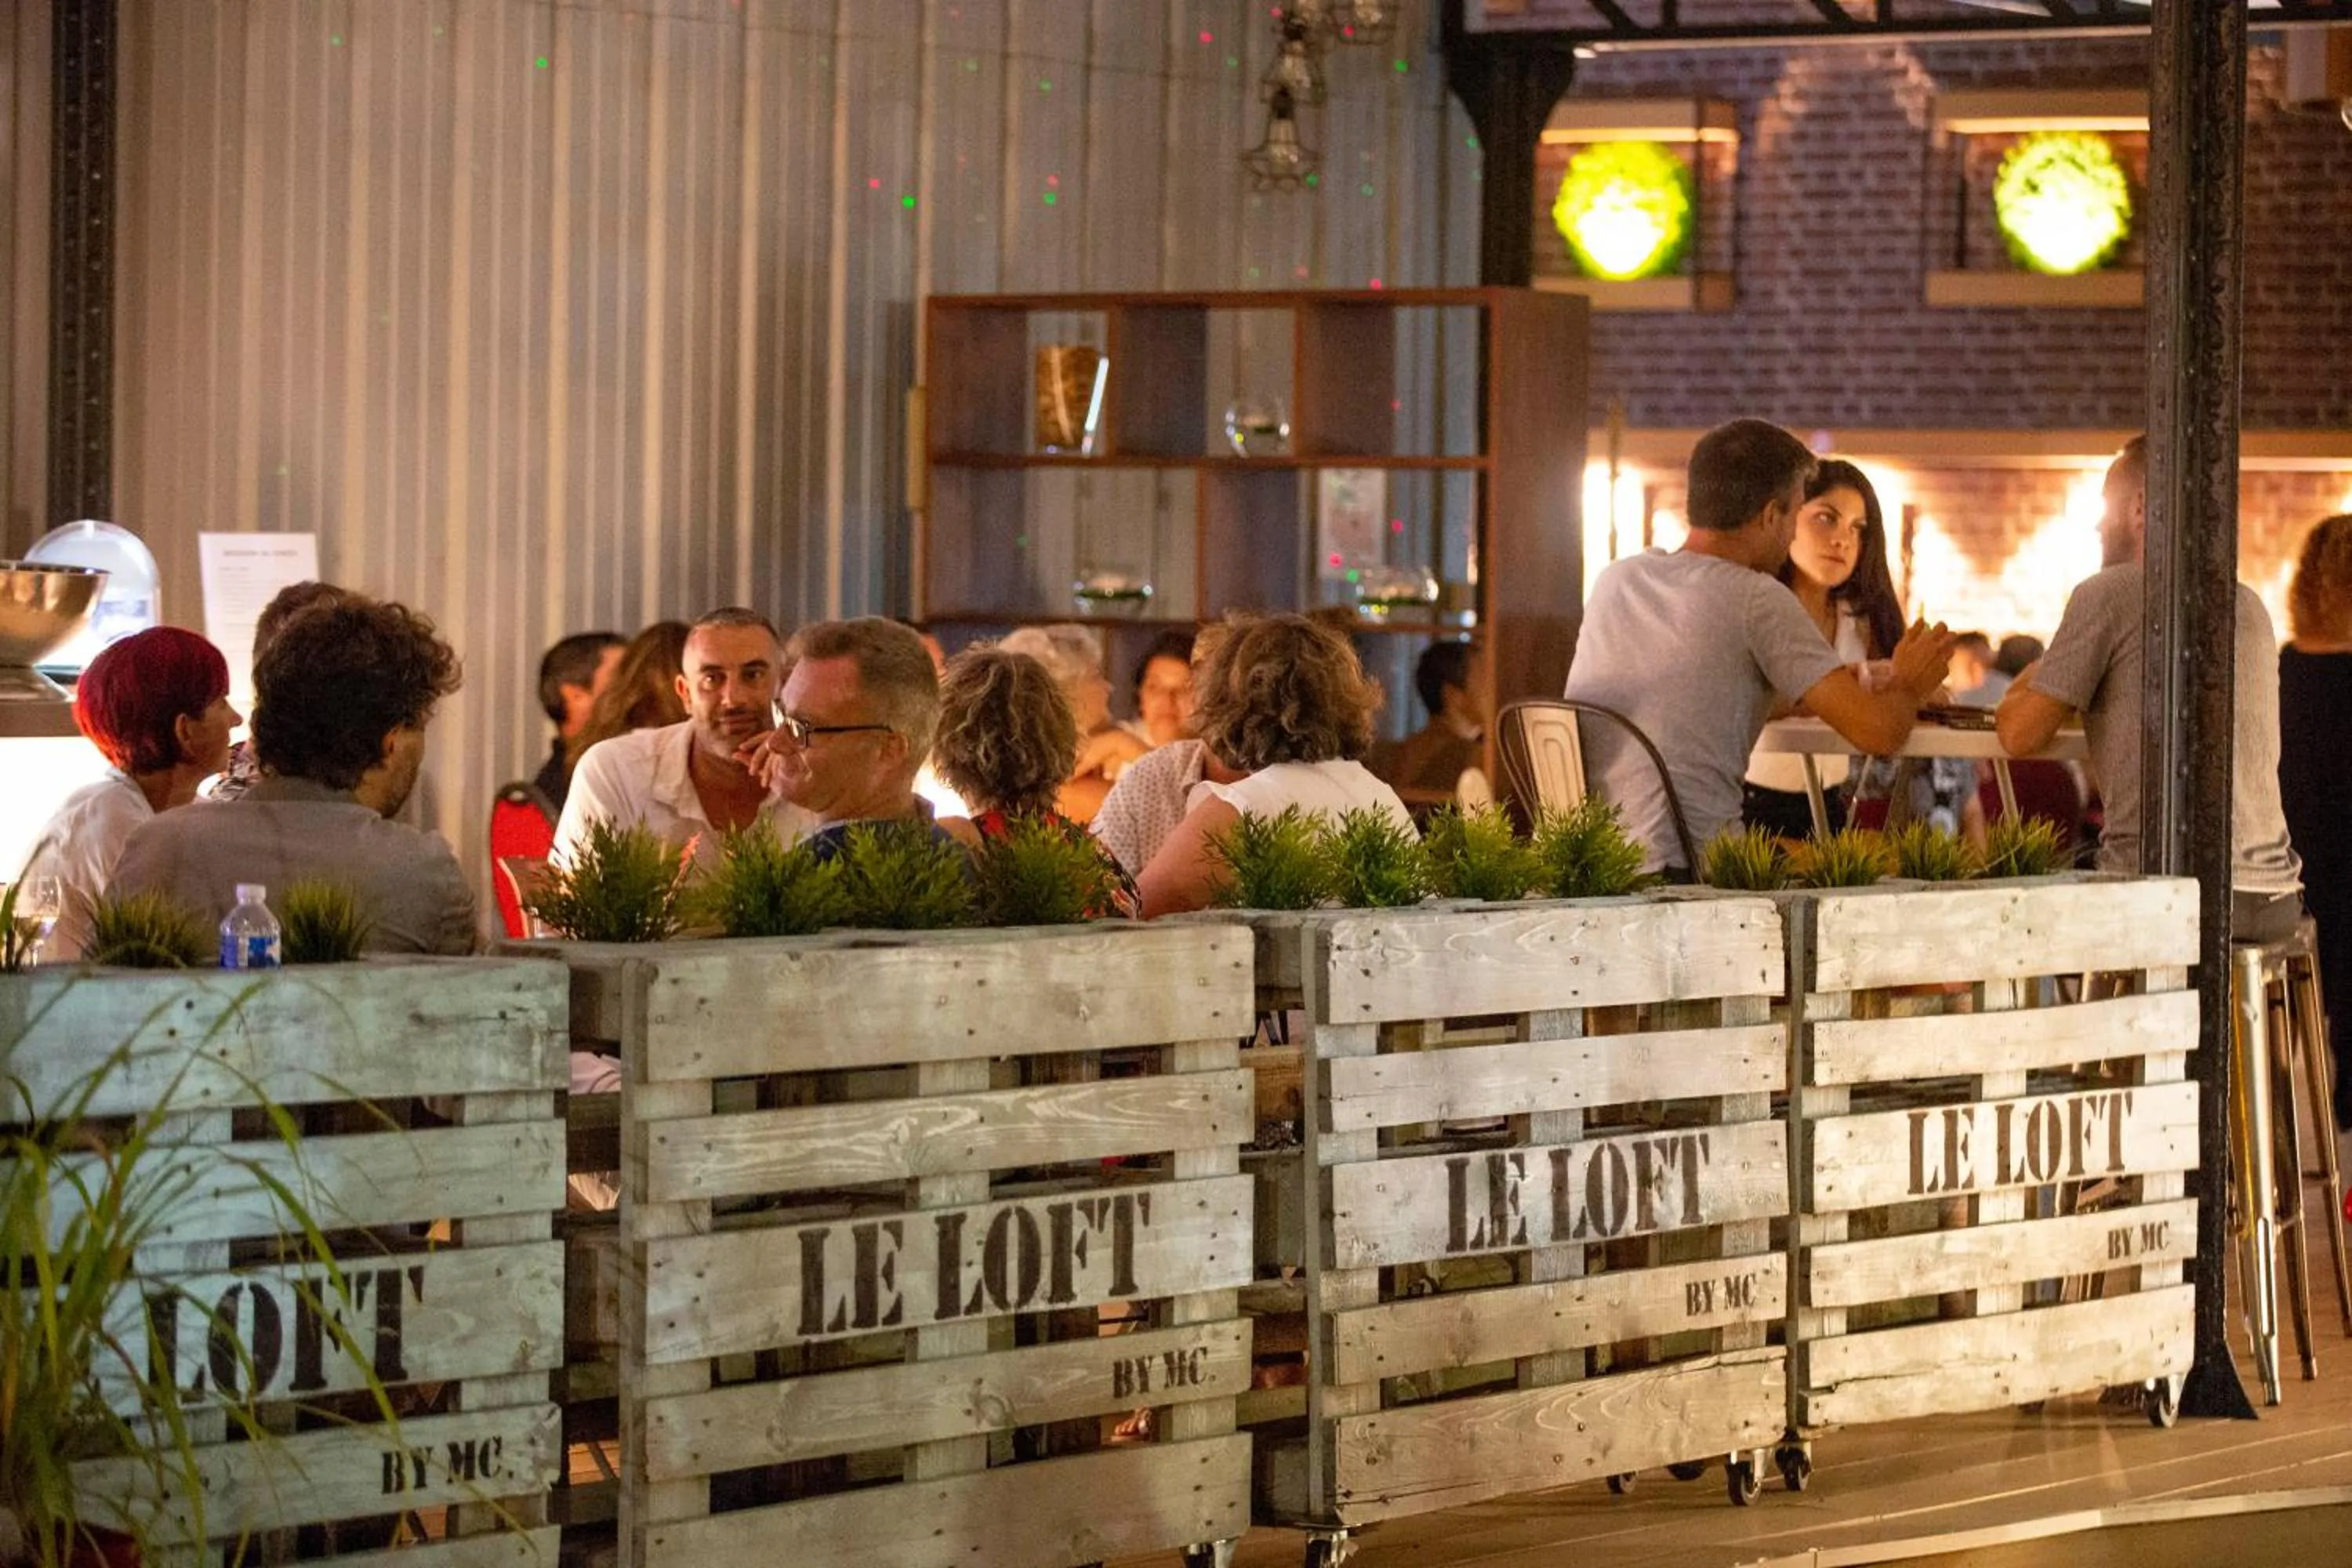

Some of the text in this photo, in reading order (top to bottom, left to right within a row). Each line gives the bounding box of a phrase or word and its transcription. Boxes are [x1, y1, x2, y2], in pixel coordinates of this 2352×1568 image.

[1907, 1091, 2133, 1195] LE LOFT
[1445, 1134, 1710, 1254] LE LOFT
[797, 1192, 1150, 1335] LE LOFT
[2107, 1220, 2169, 1260] BY MC
[1686, 1272, 1757, 1316] BY MC
[144, 1264, 424, 1406] LOFT
[1113, 1355, 1154, 1399] BY
[381, 1445, 434, 1495] BY
